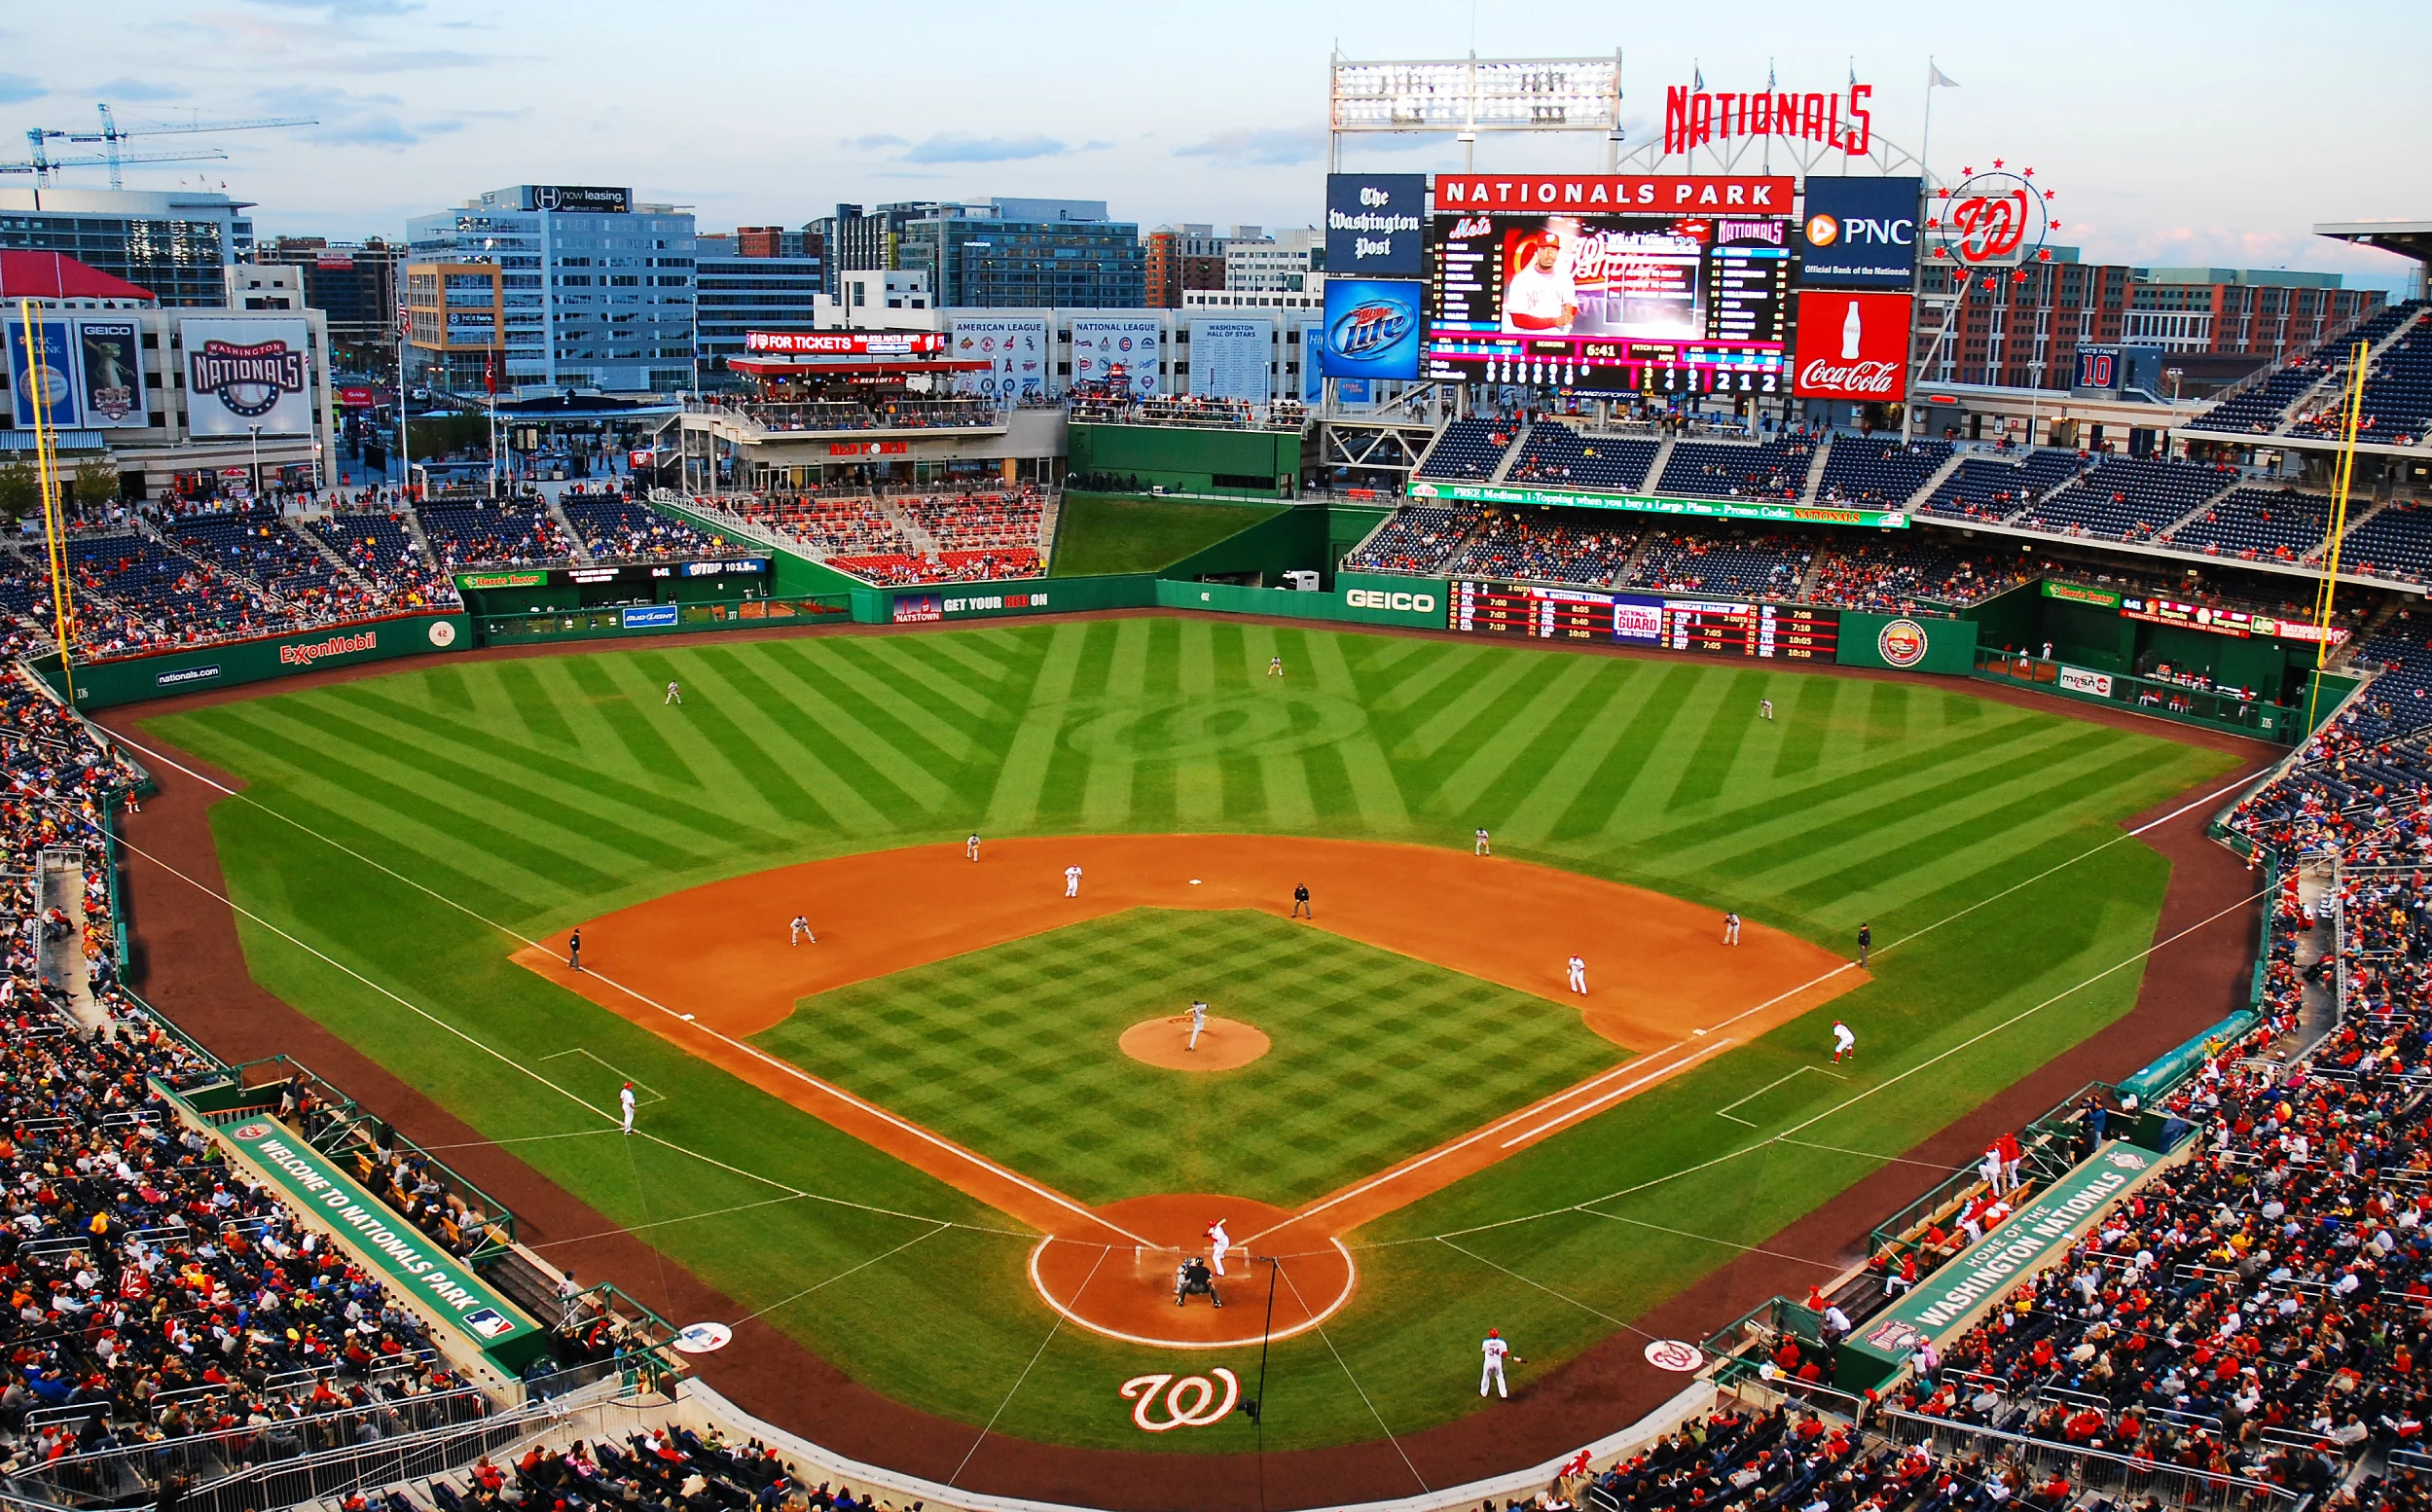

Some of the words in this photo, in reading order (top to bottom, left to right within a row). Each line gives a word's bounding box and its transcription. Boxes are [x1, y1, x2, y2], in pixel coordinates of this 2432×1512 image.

[1664, 85, 1871, 156] NATIONALS
[585, 190, 624, 202] leasing.
[1360, 187, 1390, 207] The
[1446, 183, 1655, 203] NATIONALS
[1675, 185, 1773, 206] PARK
[1329, 208, 1420, 234] Washington
[1449, 217, 1492, 239] Mets
[1718, 221, 1784, 244] NATIONALS
[1842, 218, 1913, 245] PNC
[1355, 237, 1392, 260] Post
[1804, 265, 1832, 273] Official
[1833, 266, 1852, 274] Bank
[1853, 266, 1862, 274] of
[1862, 267, 1873, 275] the
[1874, 267, 1910, 275] Nationals
[84, 326, 131, 336] GEICO
[956, 323, 1005, 332] AMERICAN
[1005, 323, 1042, 332] LEAGUE
[1076, 323, 1115, 332] NATIONAL
[1116, 323, 1156, 332] LEAGUE
[1341, 315, 1405, 355] Lite
[210, 343, 280, 356] WASHINGTON
[770, 335, 792, 349] FOR
[794, 335, 852, 350] TICKETS
[1586, 344, 1615, 357] 6:41
[196, 355, 299, 389] NATIONALS
[1502, 361, 1510, 372] 2
[1645, 368, 1653, 378] 3
[1665, 368, 1675, 379] 4
[1688, 370, 1697, 379] 0
[1800, 358, 1900, 393] Coca-Cola
[2081, 355, 2112, 387] 10
[1644, 379, 1652, 389] 1
[1664, 379, 1675, 390] 4
[1688, 380, 1697, 391] 2
[1717, 374, 1730, 389] 2
[1740, 374, 1752, 391] 1
[1761, 375, 1776, 392] 2
[829, 443, 858, 455] RED
[1453, 487, 1481, 498] FREE
[1483, 488, 1522, 500] Medium
[1576, 495, 1602, 506] when
[1605, 498, 1622, 509] you
[1625, 498, 1644, 510] buy
[1655, 499, 1685, 513] Large
[1687, 502, 1713, 514] Pizza
[1724, 504, 1758, 517] Promo
[1760, 507, 1791, 519] Code:
[1794, 509, 1861, 522] NATIONALS
[476, 576, 508, 587] Harris
[510, 574, 539, 585] Teeter
[944, 598, 967, 612] GET
[968, 596, 1001, 610] YOUR
[1004, 594, 1029, 608] RED
[1031, 594, 1048, 606] ON
[1346, 589, 1434, 613] GEICO
[2059, 587, 2087, 599] Harris
[2087, 592, 2114, 604] Teeter
[728, 610, 738, 621] 377
[896, 613, 939, 622] NATSTOWN
[1618, 616, 1657, 631] GUARD
[1794, 611, 1812, 620] 7:08
[2128, 612, 2160, 623] WASHINGTON
[2160, 617, 2188, 627] NATIONALS
[2189, 622, 2206, 630] DREAM
[2207, 625, 2239, 636] FOUNDATION
[437, 630, 447, 638] 42
[1793, 624, 1811, 632] 7:10
[280, 631, 377, 666] ExxonMobil
[1789, 636, 1812, 645] 10:05
[1789, 649, 1811, 658] 10:10
[158, 666, 219, 684] nationals.com
[259, 1139, 333, 1193] WELCOME
[319, 1187, 350, 1207] TO
[337, 1205, 435, 1275] NATIONALS
[420, 1271, 481, 1312] PARK
[1966, 1240, 2008, 1268] HOME
[2005, 1224, 2023, 1239] OF
[2021, 1205, 2052, 1225] THE
[1914, 1231, 2046, 1328] WASHINGTON
[2032, 1170, 2126, 1240] NATIONALS
[1489, 1348, 1500, 1356] 34
